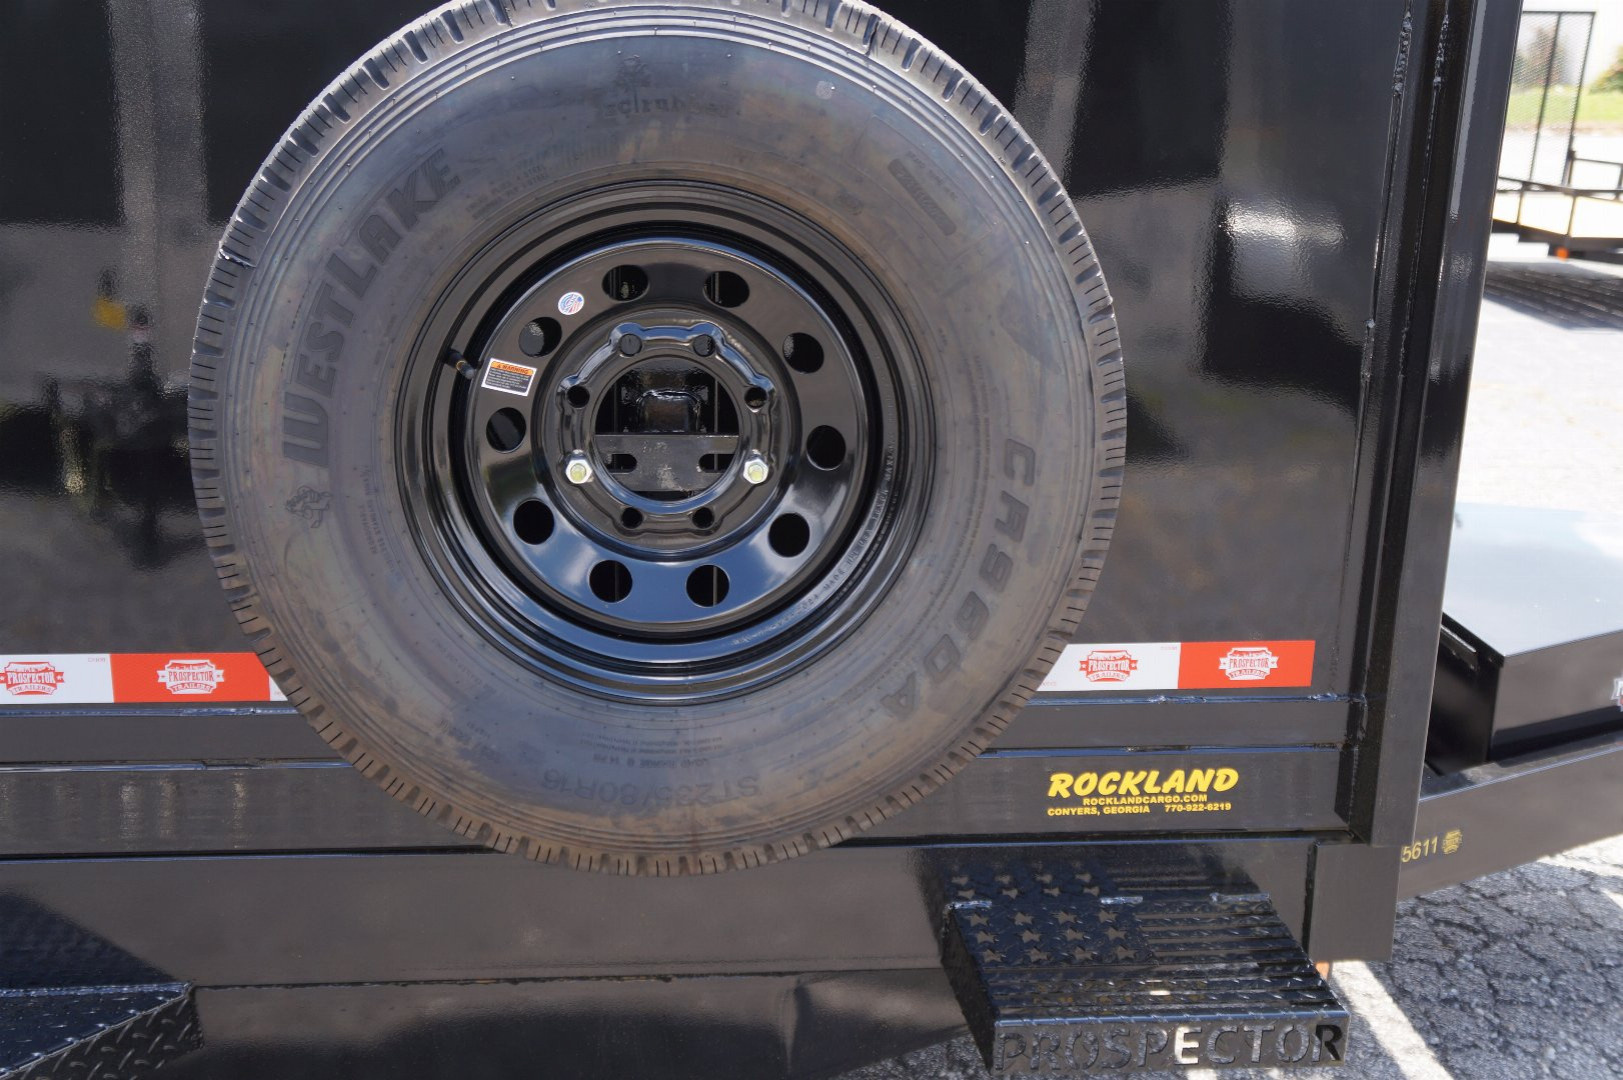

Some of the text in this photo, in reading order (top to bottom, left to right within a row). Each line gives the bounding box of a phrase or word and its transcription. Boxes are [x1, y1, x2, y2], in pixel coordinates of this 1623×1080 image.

[281, 147, 461, 469] WESTLAKE
[1088, 659, 1130, 672] PROSPECTOR
[1229, 657, 1270, 669] PROSPECTOR
[6, 671, 56, 685] PROSPECTOR
[168, 670, 215, 682] PROSPECTOR
[13, 684, 51, 692] TRAILERS
[173, 681, 212, 692] TRAILERS
[1047, 768, 1240, 798] ROCKLAND
[1083, 794, 1208, 806] ROCKLANDCARGO.COM
[1047, 806, 1101, 816] CONYERS,
[1103, 805, 1151, 815] GEORGIA
[1401, 835, 1438, 863] 5611
[996, 1024, 1343, 1071] PROSPECTOR
